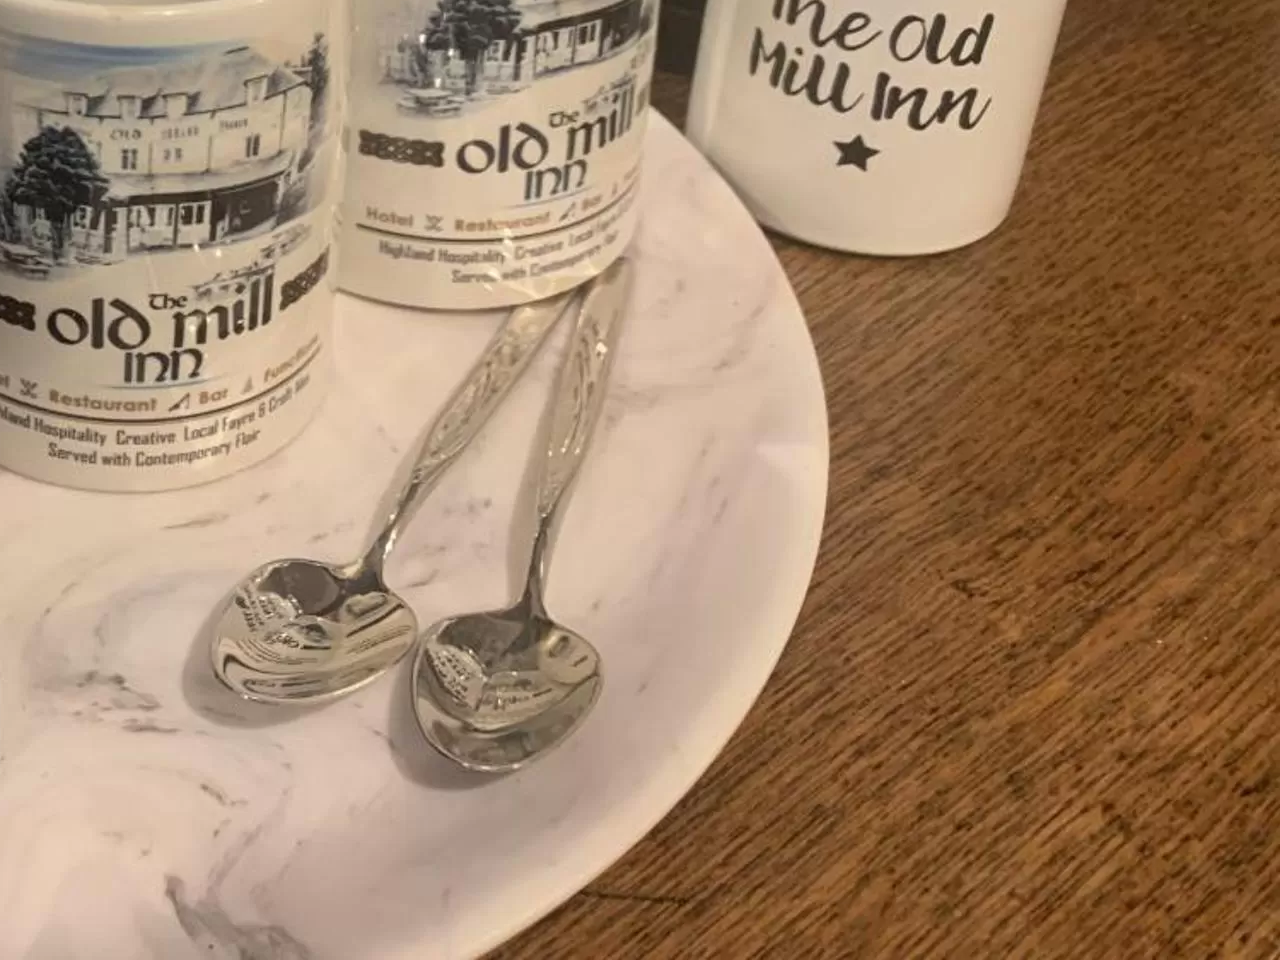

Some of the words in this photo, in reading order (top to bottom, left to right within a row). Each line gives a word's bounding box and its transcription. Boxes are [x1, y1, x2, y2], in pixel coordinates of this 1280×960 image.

[888, 13, 994, 66] Old
[749, 27, 865, 113] Mill
[870, 71, 992, 130] Inn
[456, 124, 549, 174] old
[566, 84, 634, 160] mill
[549, 110, 579, 128] The
[524, 159, 587, 200] inn
[365, 206, 414, 228] Hotel
[47, 297, 151, 350] old
[173, 271, 275, 348] mill
[148, 293, 188, 312] The
[124, 348, 204, 384] inn
[49, 389, 157, 412] Restaurant
[199, 388, 228, 405] Bar
[34, 416, 107, 447] Hospitality
[116, 429, 176, 446] Creative
[184, 420, 218, 441] Local
[222, 411, 256, 431] Fayre
[48, 442, 96, 465] Served
[102, 452, 131, 466] with
[136, 441, 231, 467] Contemporary
[235, 430, 260, 448] Flair
